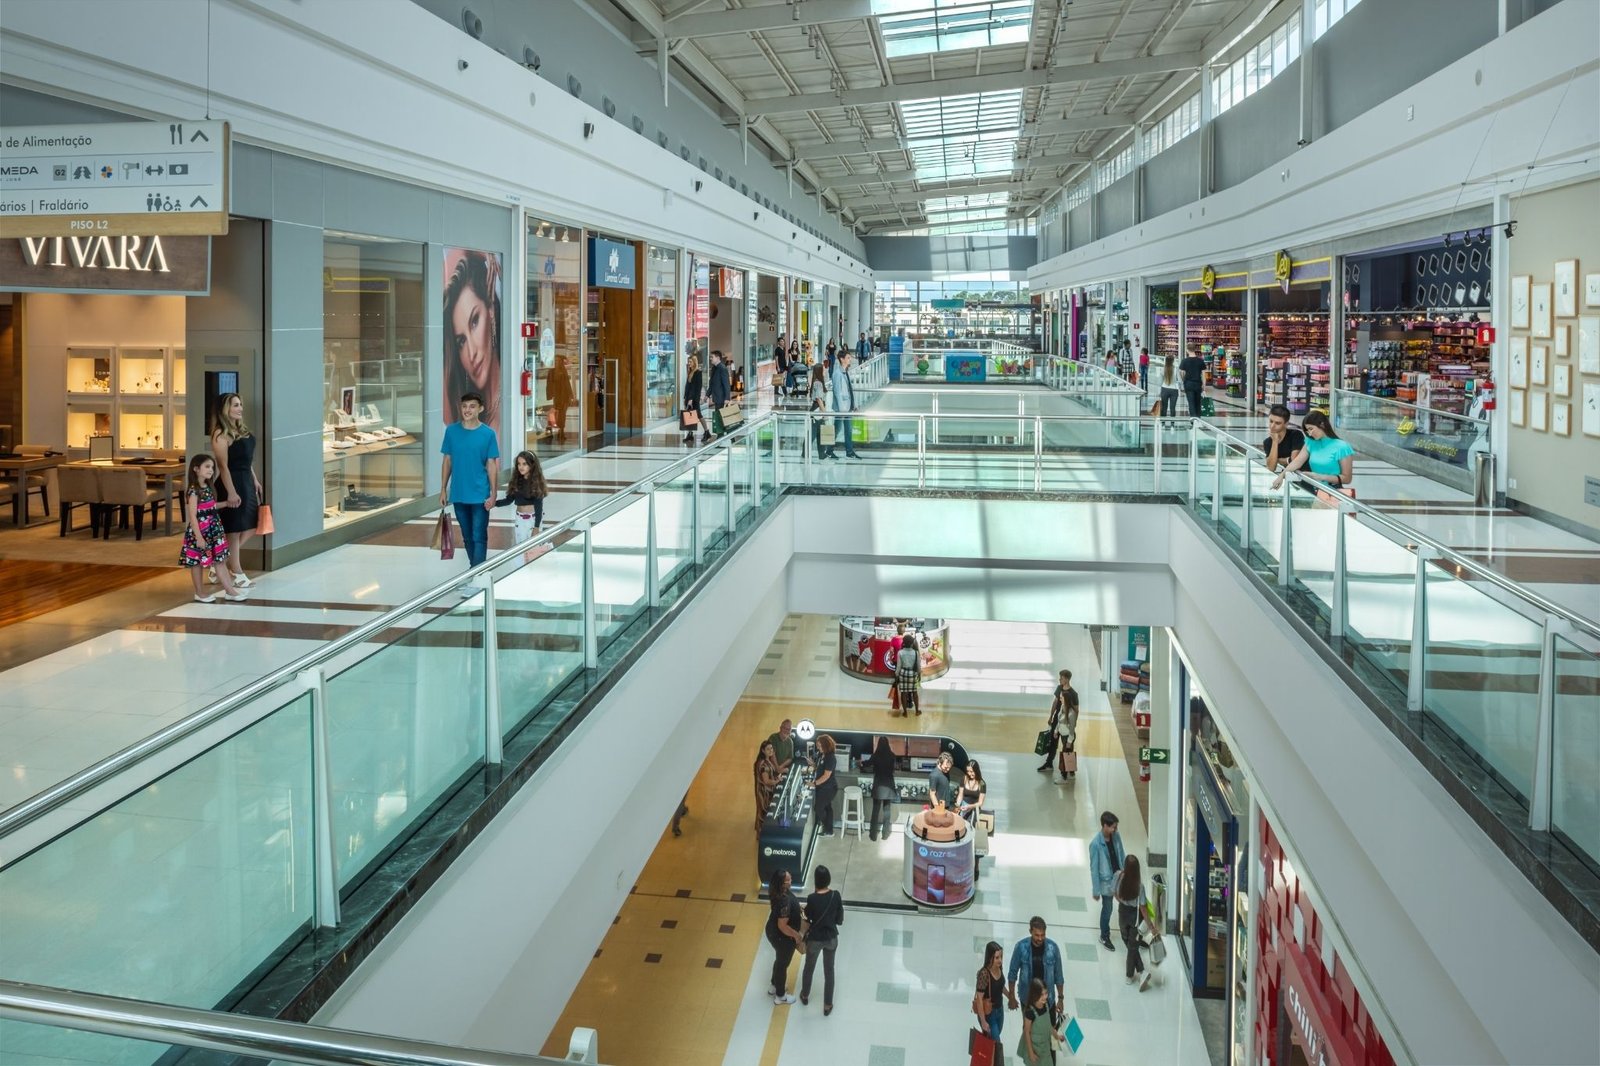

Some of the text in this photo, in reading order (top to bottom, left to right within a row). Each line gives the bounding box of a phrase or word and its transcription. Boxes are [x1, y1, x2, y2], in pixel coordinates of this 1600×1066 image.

[6, 135, 92, 149] de Alimentação
[54, 168, 66, 177] G2
[39, 199, 89, 211] Fraldário
[70, 220, 109, 230] PISO L2
[21, 235, 171, 273] VIVARA
[773, 849, 797, 857] motorola
[929, 850, 946, 858] razr
